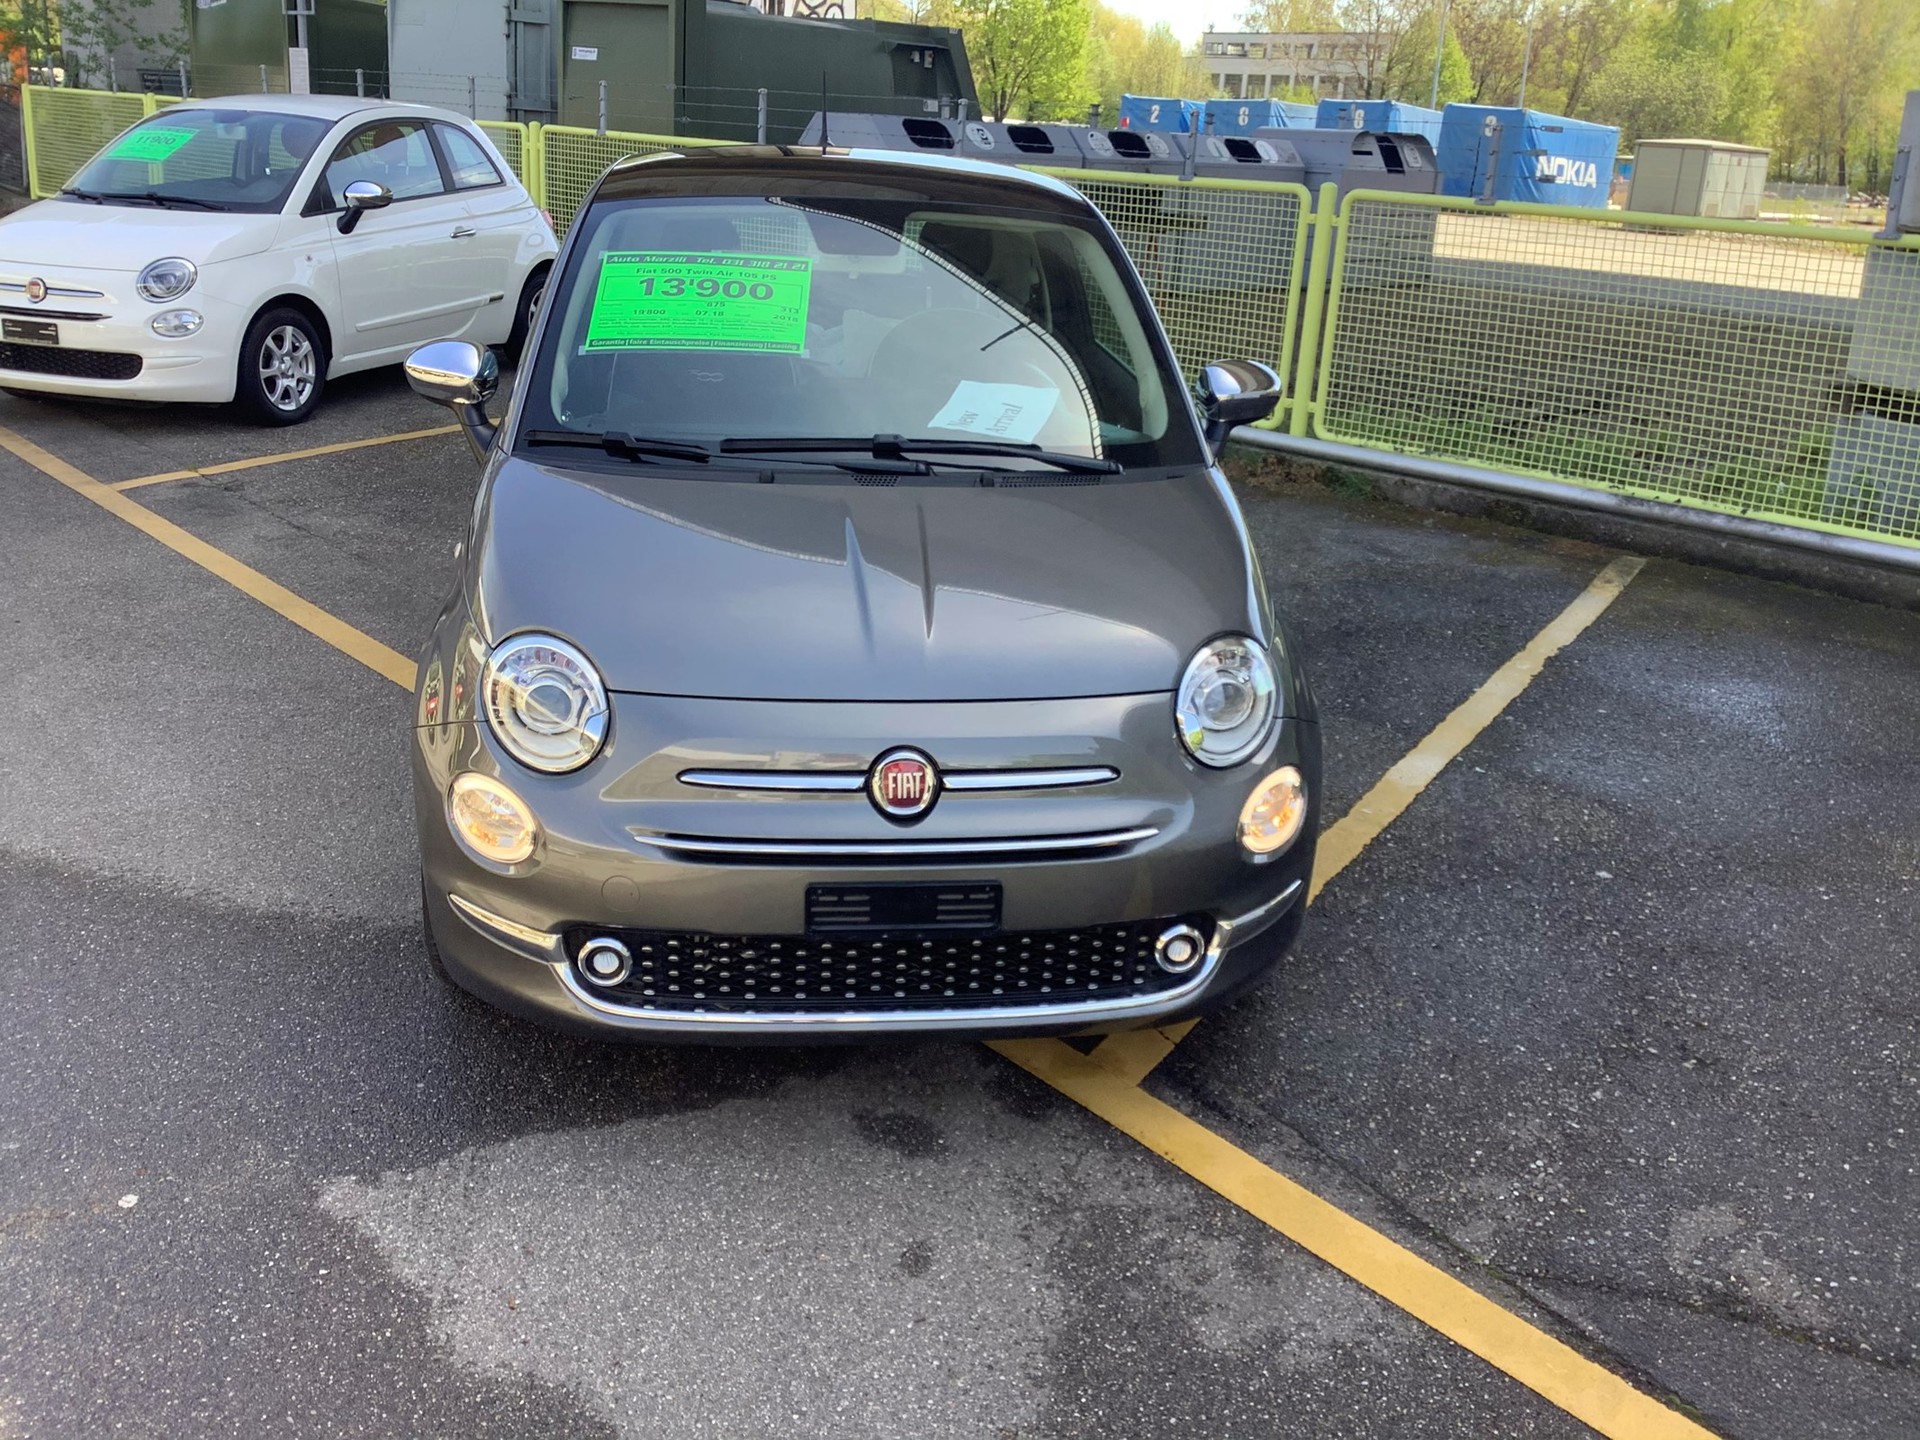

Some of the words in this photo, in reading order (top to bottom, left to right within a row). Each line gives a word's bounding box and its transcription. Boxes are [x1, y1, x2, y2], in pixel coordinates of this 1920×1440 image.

[1149, 104, 1160, 123] 2
[1535, 155, 1597, 189] NOKIA
[608, 255, 640, 263] Auto
[642, 255, 688, 264] Marzili
[696, 256, 716, 265] Tel.
[722, 258, 744, 267] 031
[748, 259, 770, 268] 318
[773, 261, 787, 270] 21
[791, 262, 807, 271] 21
[635, 267, 657, 275] Fiat
[660, 267, 683, 275] 500
[685, 268, 713, 276] Twin
[716, 269, 734, 278] Air
[738, 271, 759, 279] 105
[761, 273, 778, 281] PS
[639, 277, 775, 301] 13'900
[695, 310, 725, 318] 07.18
[887, 771, 923, 800] FIAT
